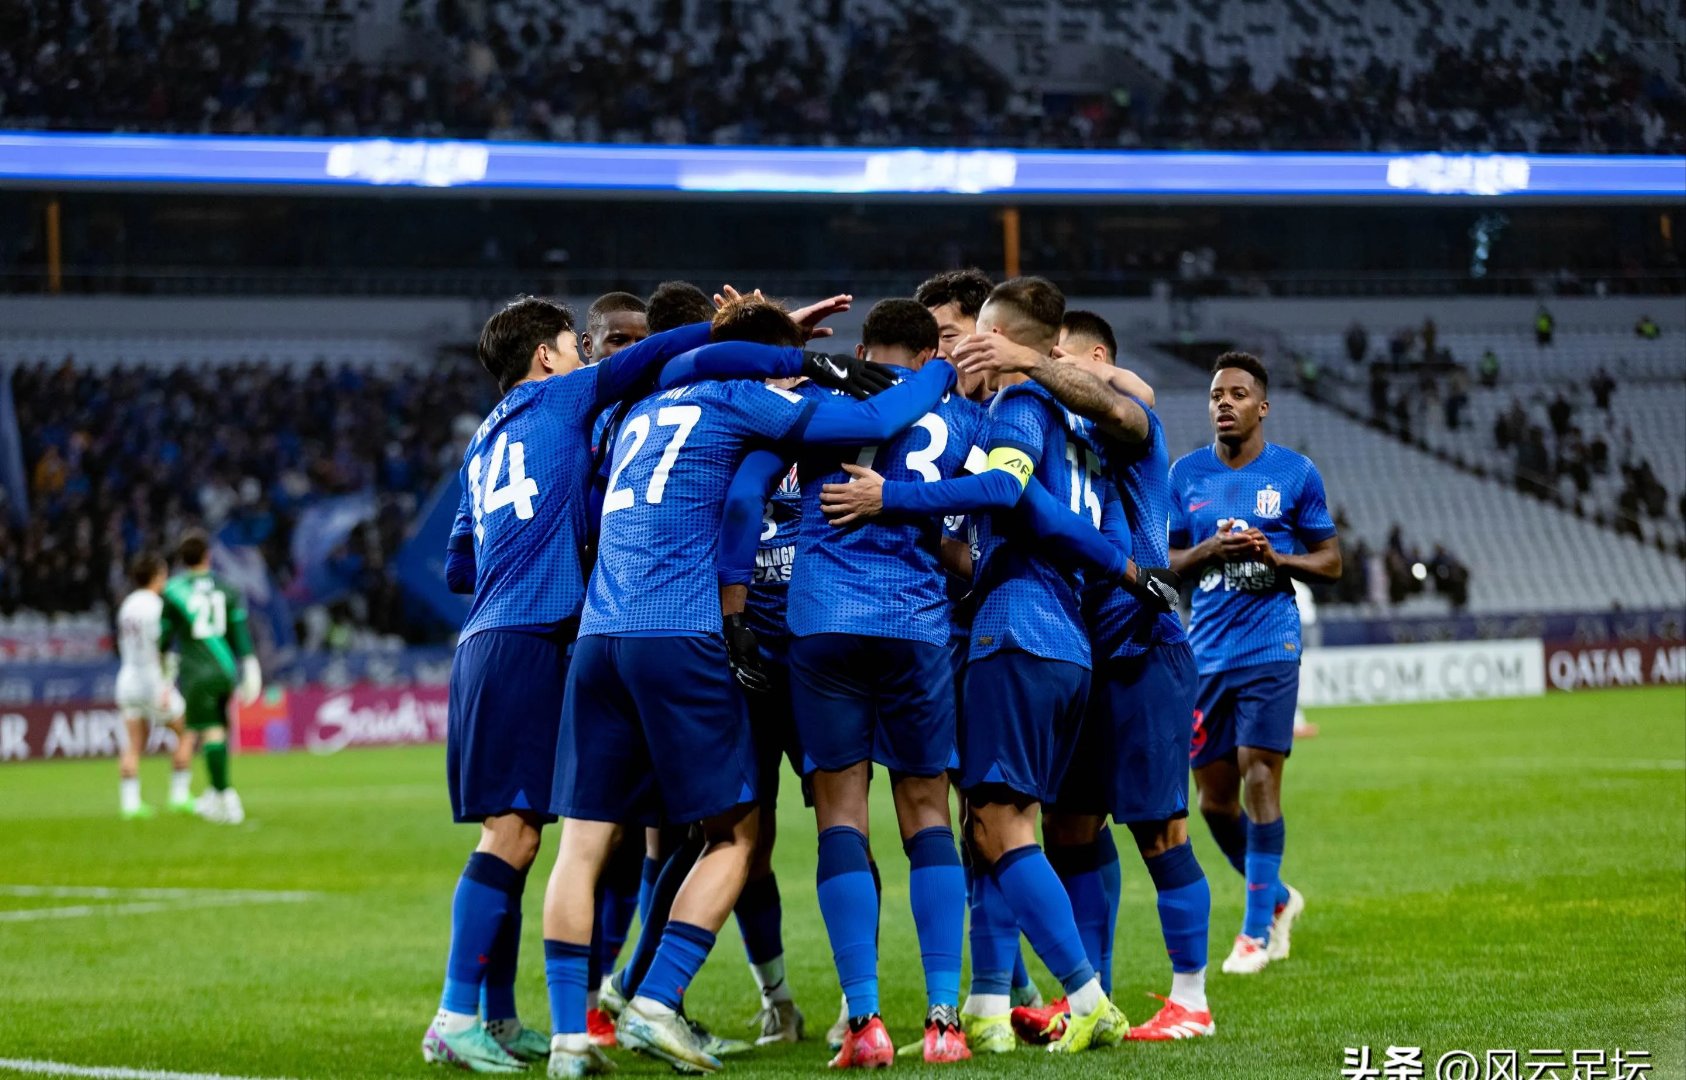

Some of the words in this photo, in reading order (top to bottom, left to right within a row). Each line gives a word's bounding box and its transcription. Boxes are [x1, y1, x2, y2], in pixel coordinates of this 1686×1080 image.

[602, 405, 702, 516] 27
[468, 431, 540, 545] 14
[751, 564, 793, 584] PAS
[1224, 575, 1276, 592] PASS
[1550, 648, 1642, 692] QATAR
